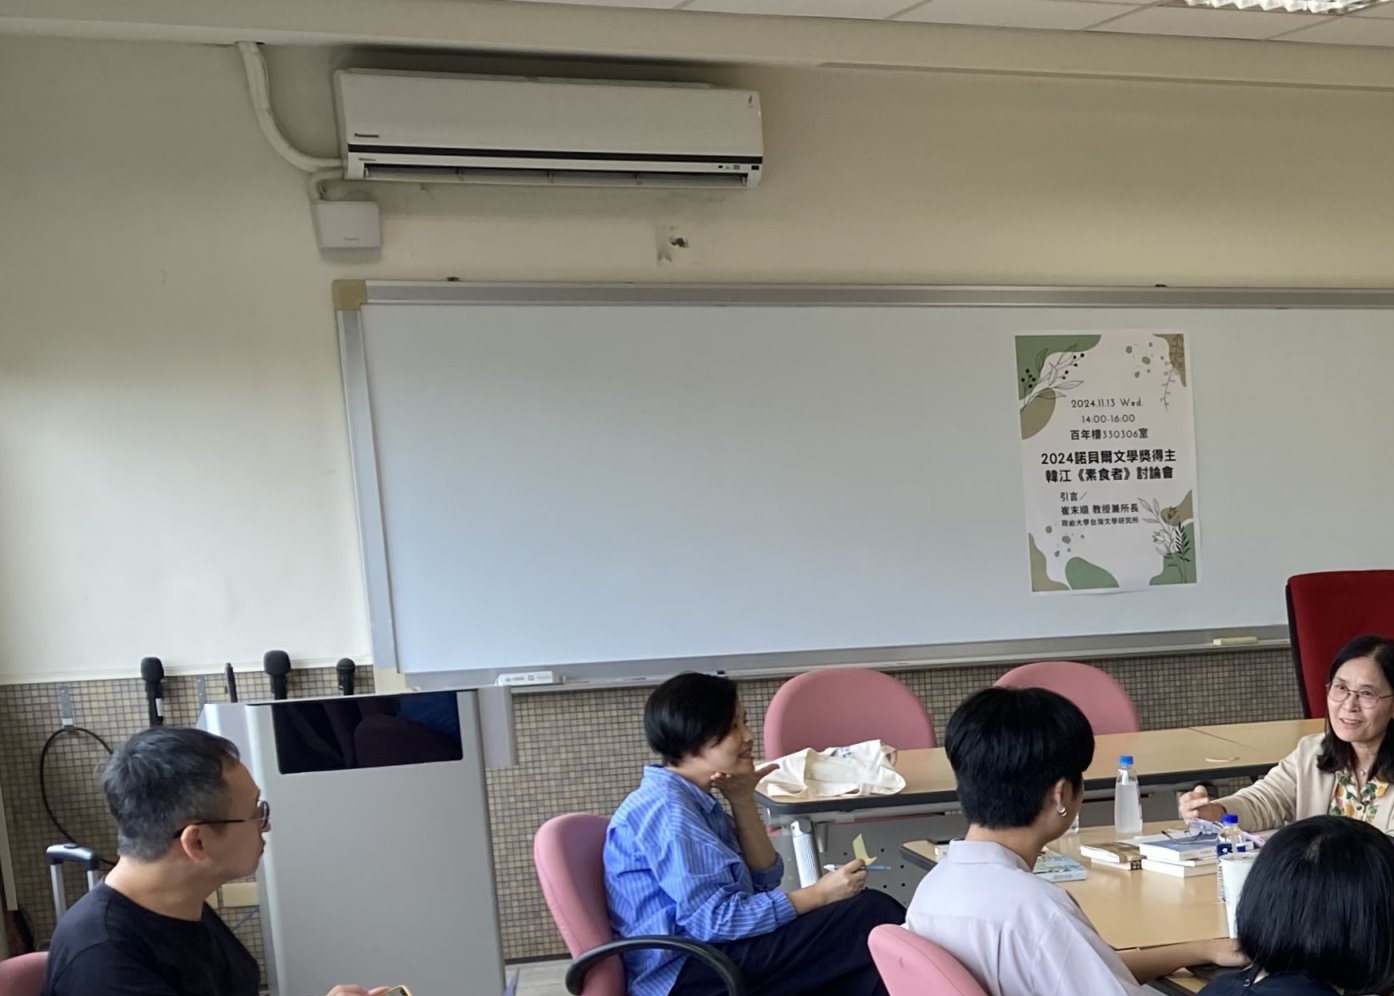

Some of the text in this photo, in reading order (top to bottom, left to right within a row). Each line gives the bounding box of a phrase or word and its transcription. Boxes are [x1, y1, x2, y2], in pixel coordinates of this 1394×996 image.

[1071, 397, 1115, 408] 2024.11.13
[1081, 414, 1136, 423] 14:00-16:00
[1070, 428, 1149, 440] 百年樓330306室
[1041, 449, 1176, 465] 2024諾貝爾文學獎得主
